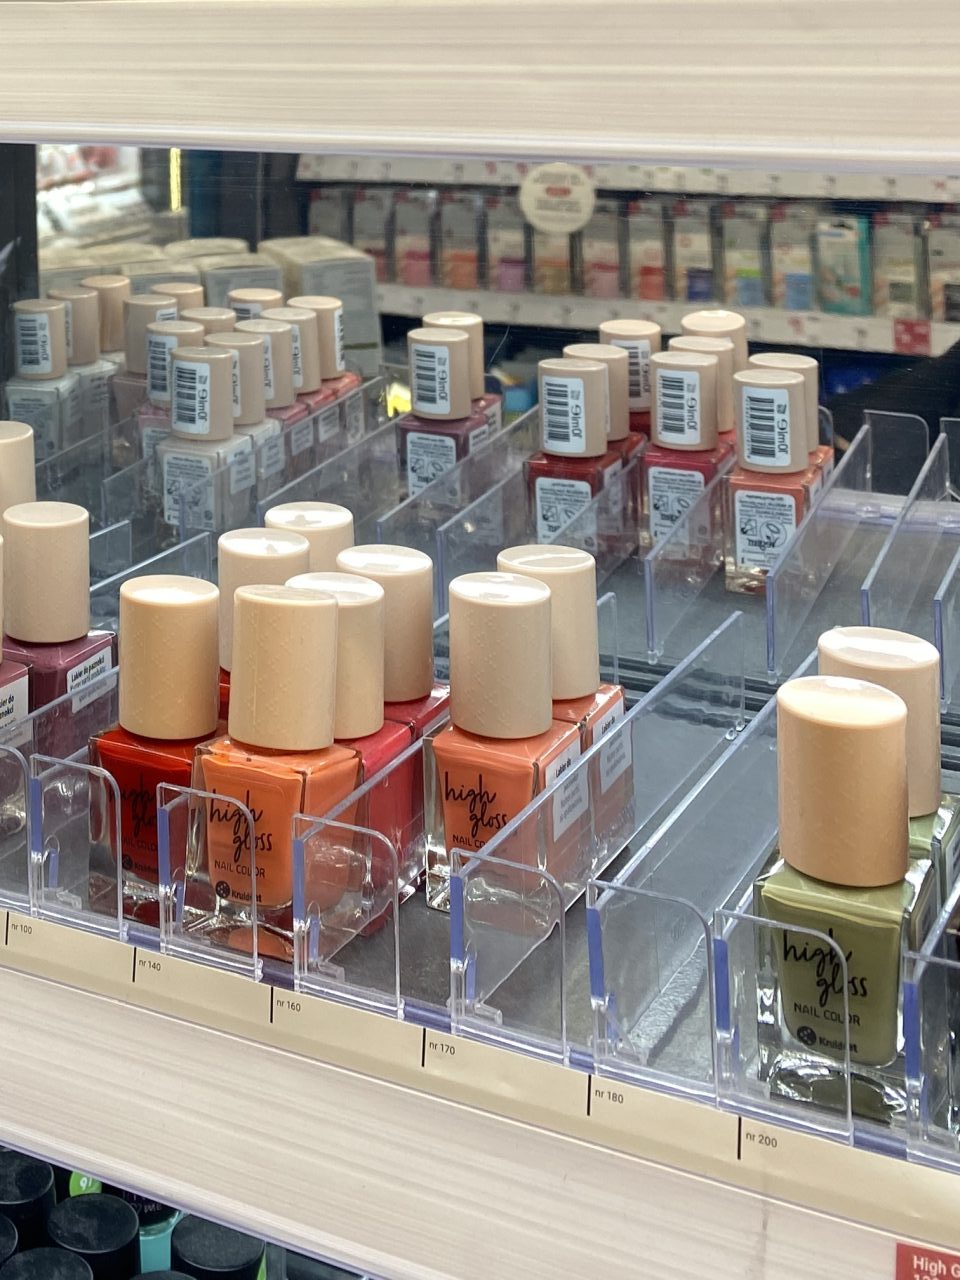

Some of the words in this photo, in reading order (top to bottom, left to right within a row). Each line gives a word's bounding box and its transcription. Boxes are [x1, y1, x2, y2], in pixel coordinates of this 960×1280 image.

[444, 770, 496, 810] high
[209, 788, 263, 834] high
[469, 804, 508, 838] gloss
[231, 831, 273, 862] gloss
[452, 834, 472, 847] NAIL
[214, 859, 234, 873] NAIL
[11, 922, 19, 930] nr
[20, 924, 33, 935] 100
[782, 927, 853, 978] high
[138, 958, 147, 967] nr
[149, 961, 161, 972] 140
[815, 975, 868, 1007] gloss
[276, 998, 285, 1007] nr
[287, 1000, 301, 1012] 160
[793, 1001, 820, 1018] NAIL
[429, 1041, 438, 1051] nr
[440, 1043, 456, 1056] 170
[594, 1088, 605, 1098] nr
[606, 1089, 624, 1104] 180
[745, 1131, 757, 1142] nr
[758, 1133, 778, 1149] 200
[913, 1255, 947, 1277] High
